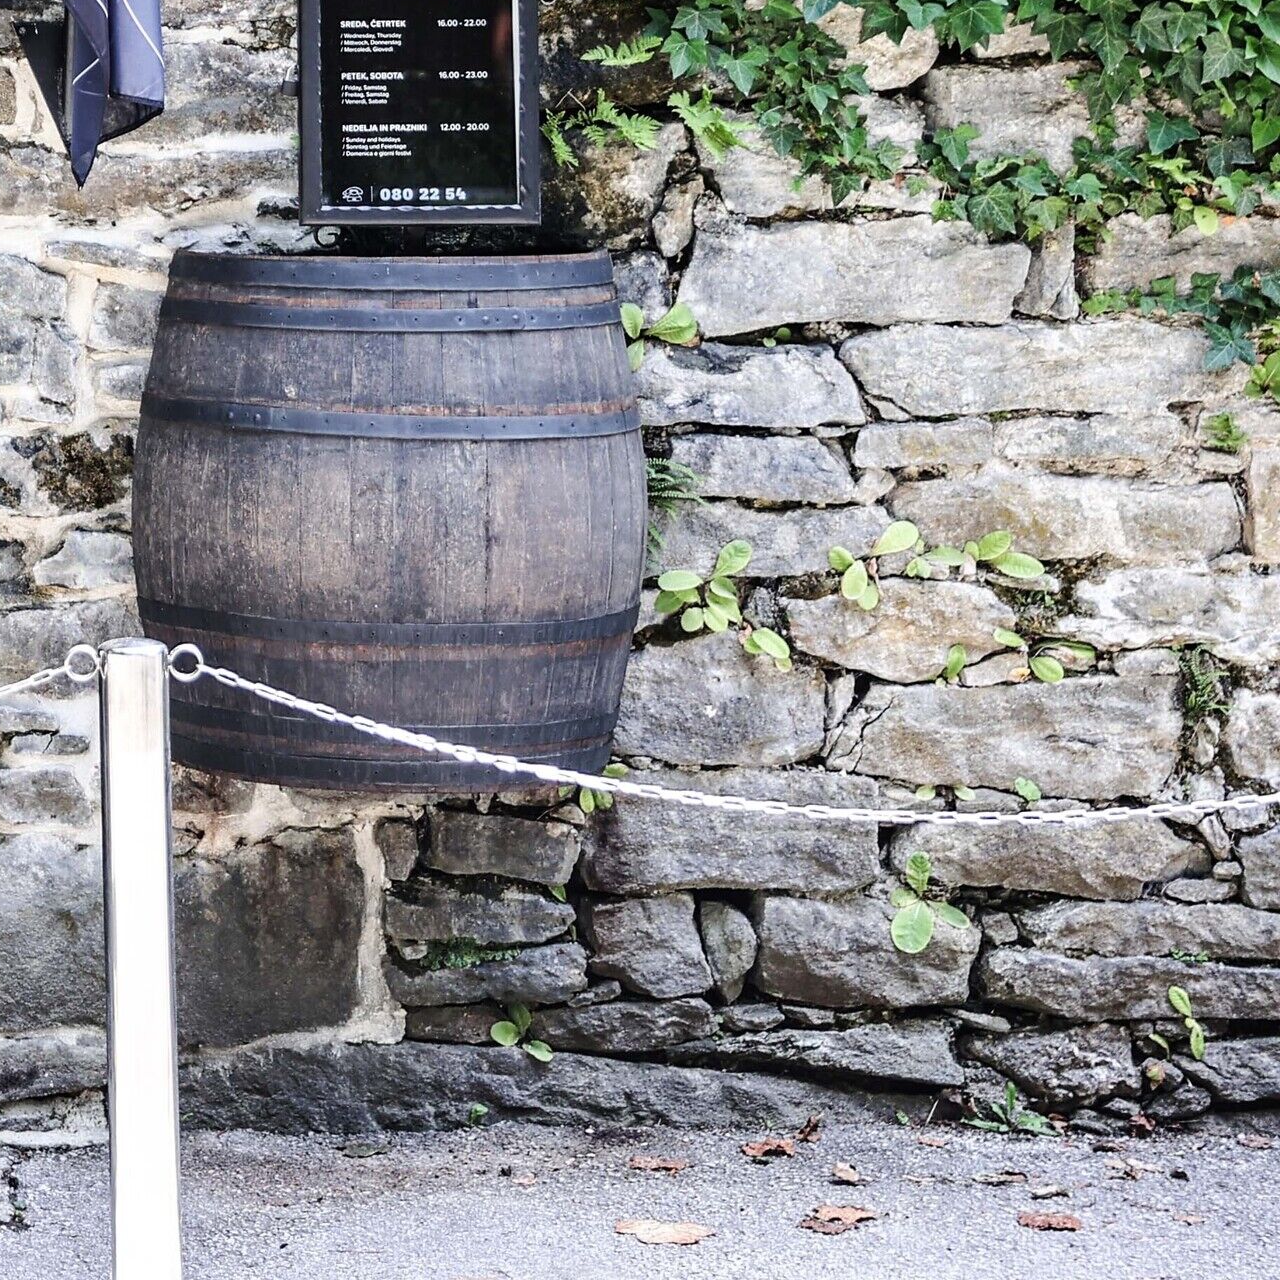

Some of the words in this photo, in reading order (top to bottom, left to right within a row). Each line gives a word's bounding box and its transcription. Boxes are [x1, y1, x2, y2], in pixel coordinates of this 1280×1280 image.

[341, 20, 369, 28] SREDA,
[370, 19, 406, 27] ČETRTEK
[341, 73, 368, 81] PETEK,
[370, 72, 404, 80] SOBOTA
[343, 124, 378, 132] NEDELJA
[380, 189, 413, 201] 080
[419, 189, 440, 200] 22
[445, 187, 466, 200] 54
